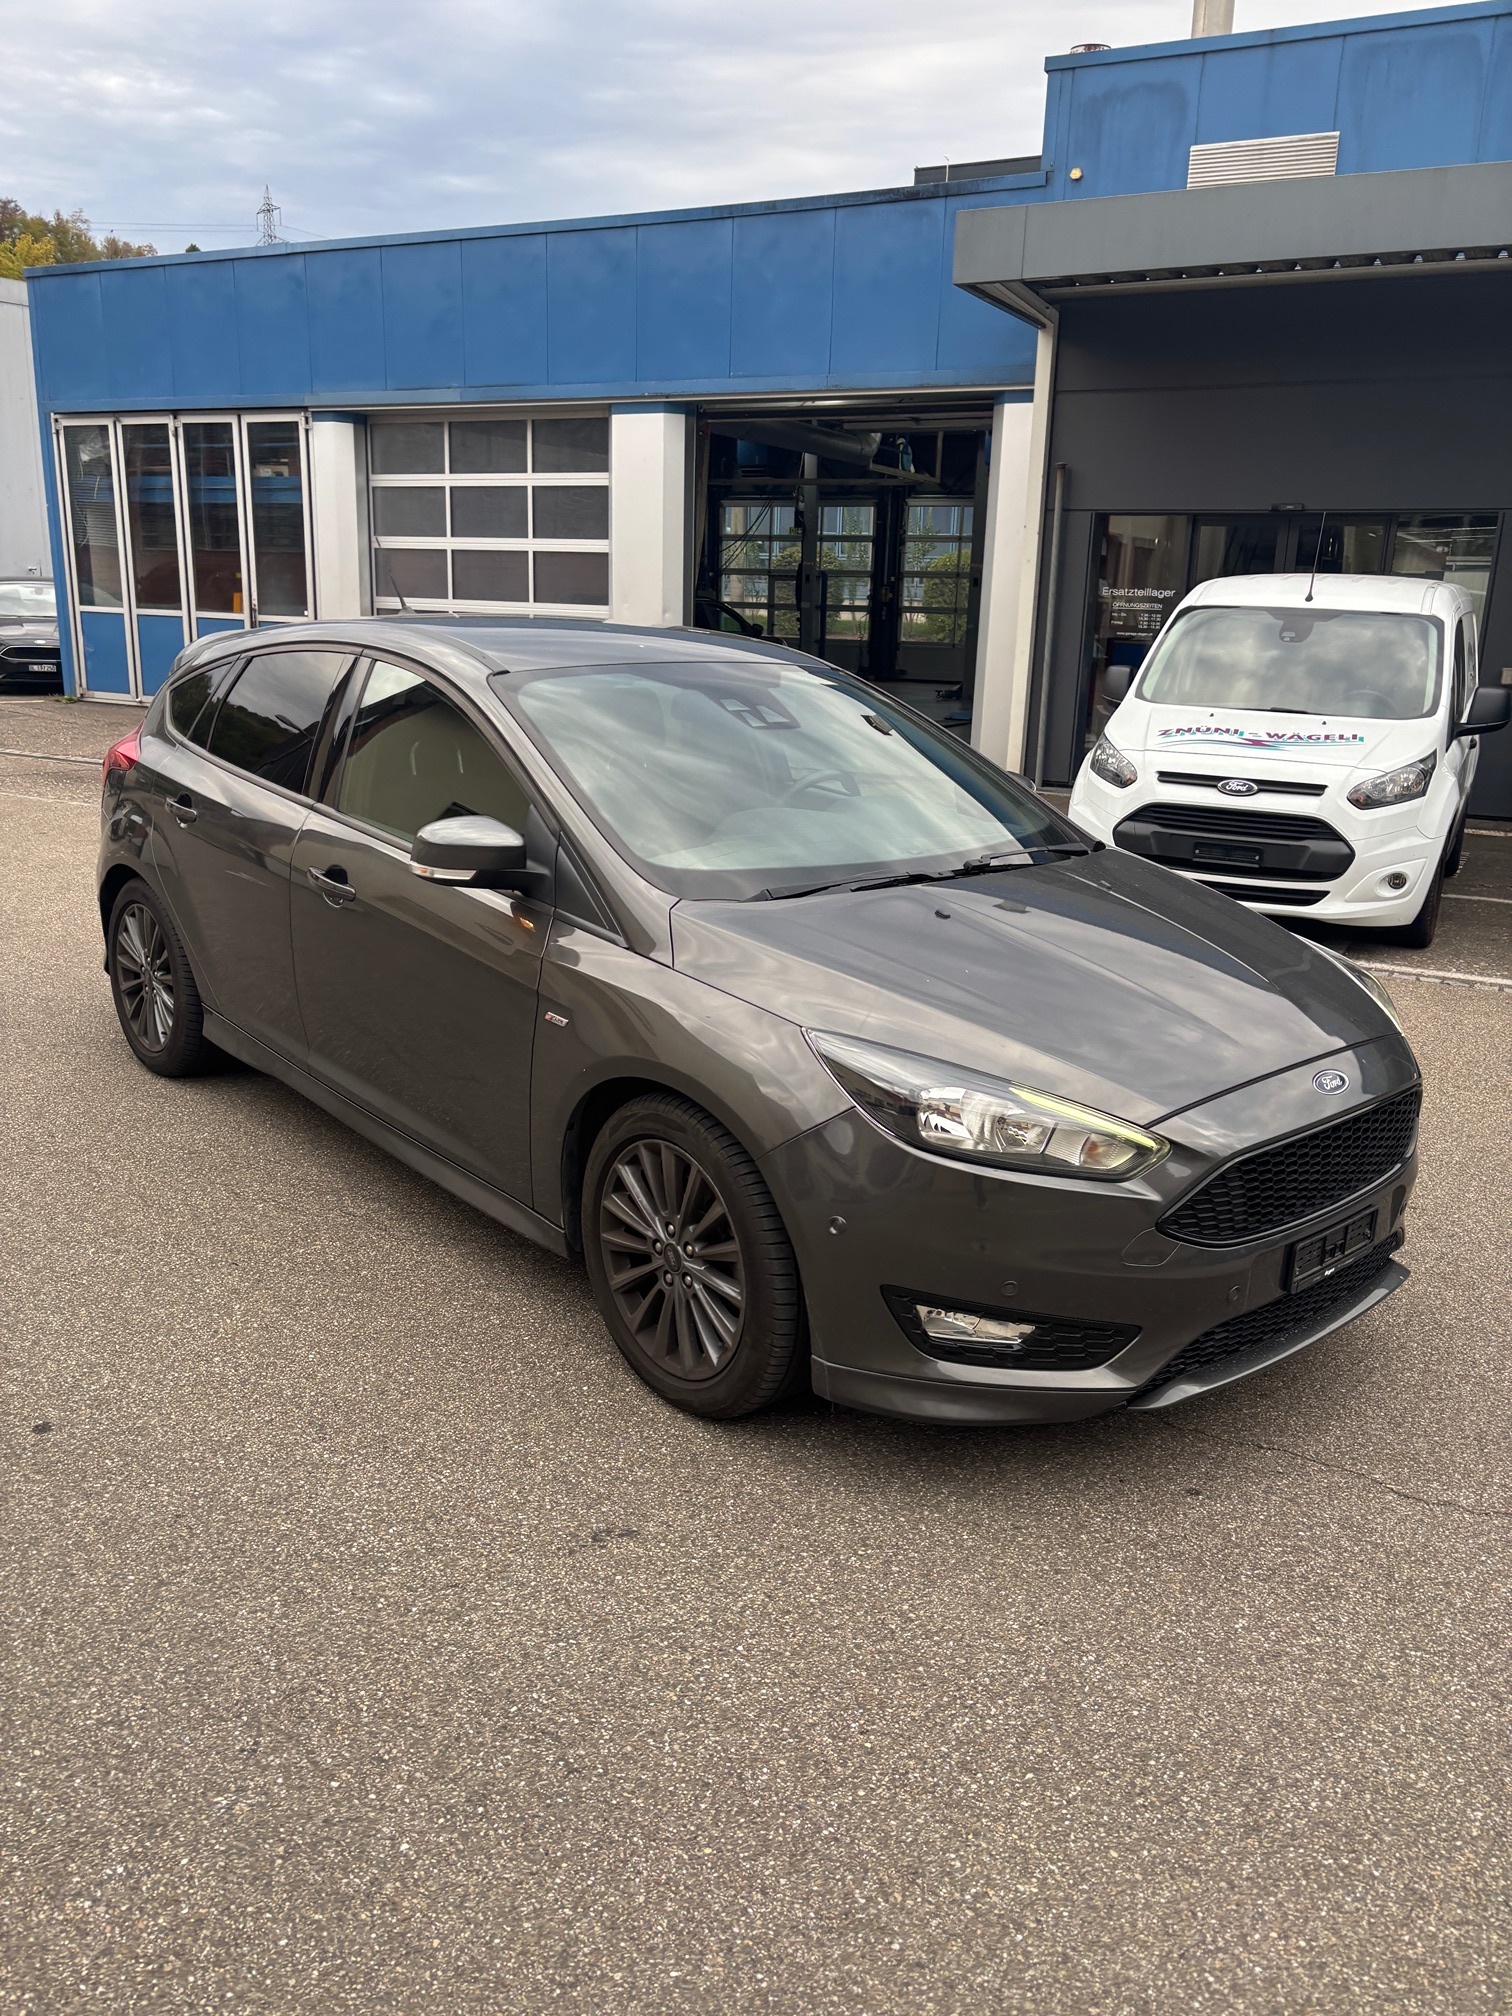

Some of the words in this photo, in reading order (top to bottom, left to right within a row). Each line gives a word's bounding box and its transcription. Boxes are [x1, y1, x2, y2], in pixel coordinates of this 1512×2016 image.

[1102, 587, 1176, 599] Ersatzteillager
[1112, 601, 1163, 609] ÖFFNUNGSZEITEN
[1157, 725, 1244, 738] ZNÜNI
[1265, 732, 1365, 743] WÄGELI
[1225, 780, 1248, 792] Ford
[1321, 1075, 1344, 1090] Ford
